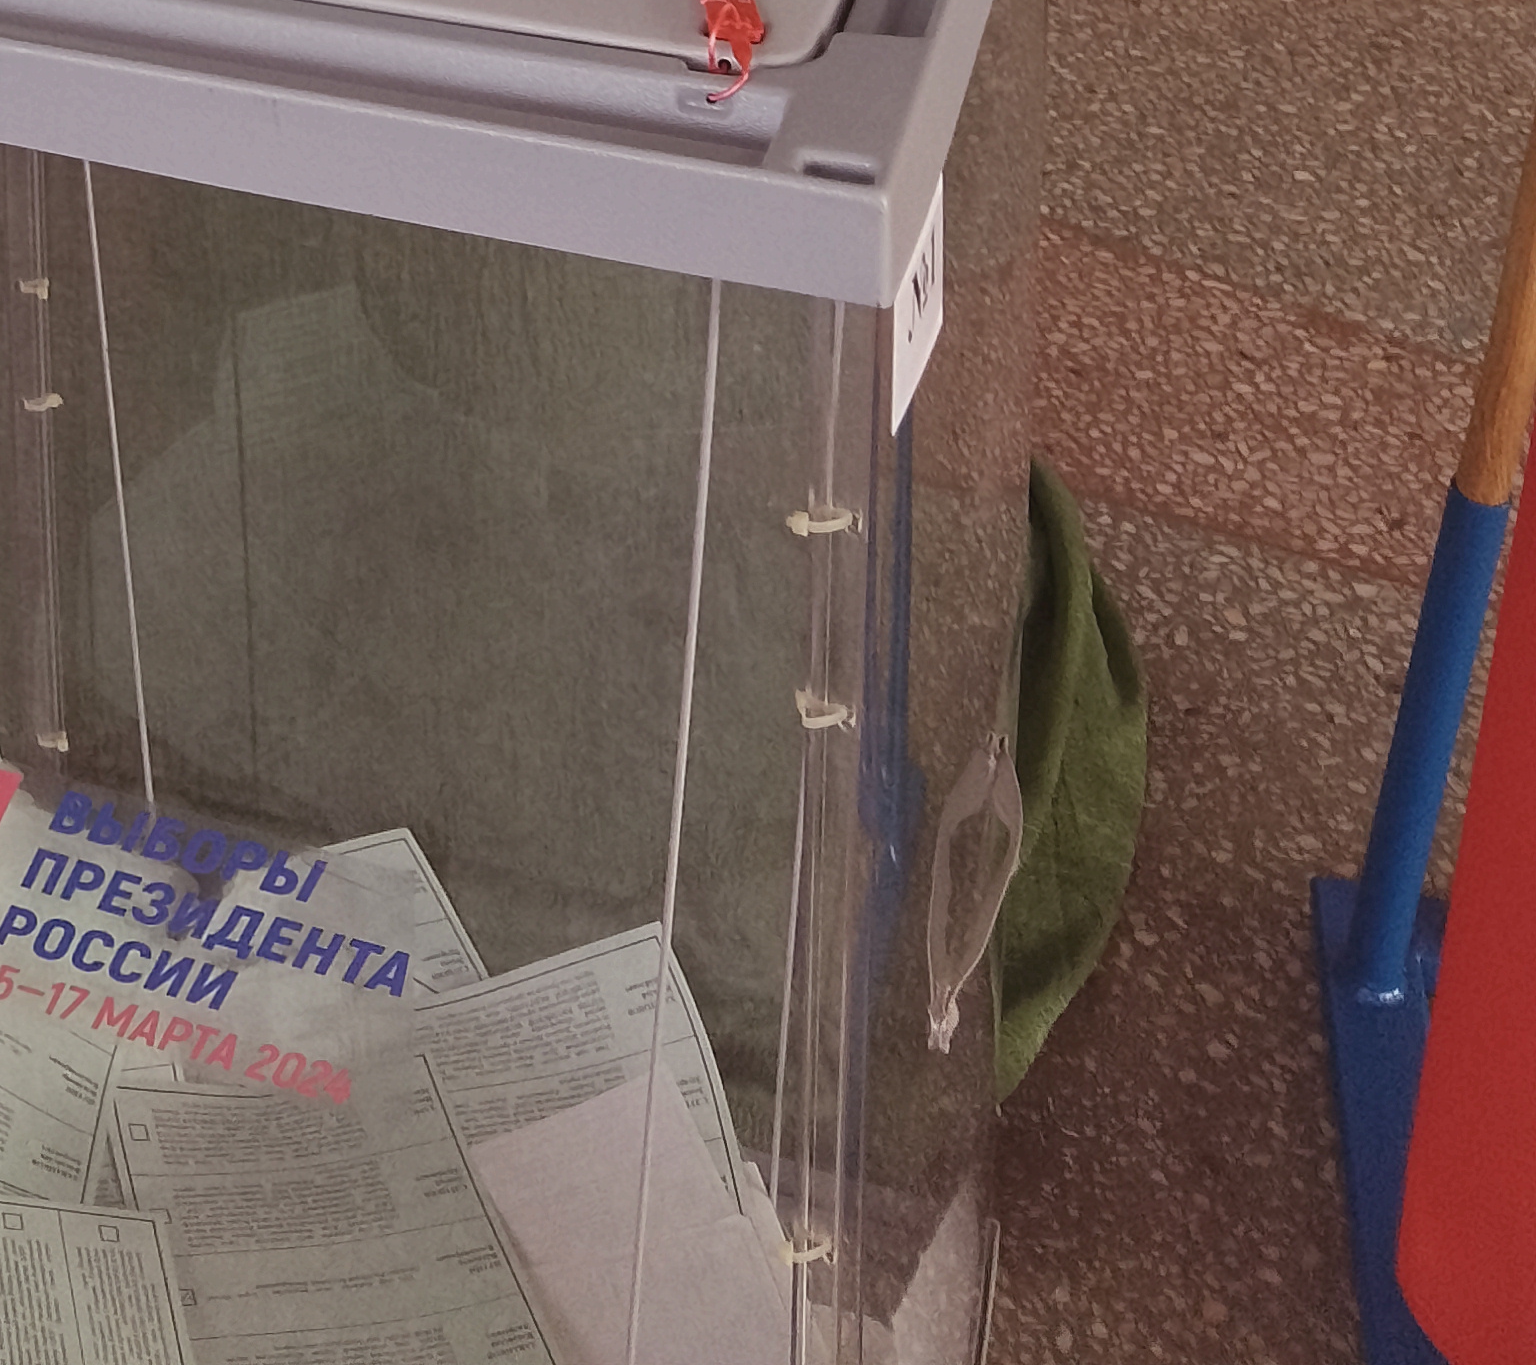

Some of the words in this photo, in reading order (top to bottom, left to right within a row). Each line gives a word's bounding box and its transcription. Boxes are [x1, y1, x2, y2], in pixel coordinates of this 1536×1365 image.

[49, 790, 328, 903] ВЫБОРЫ
[20, 847, 411, 999] ПРЕЗИДЕНТА
[91, 996, 238, 1071] МАРТА
[244, 1044, 352, 1105] 2024
